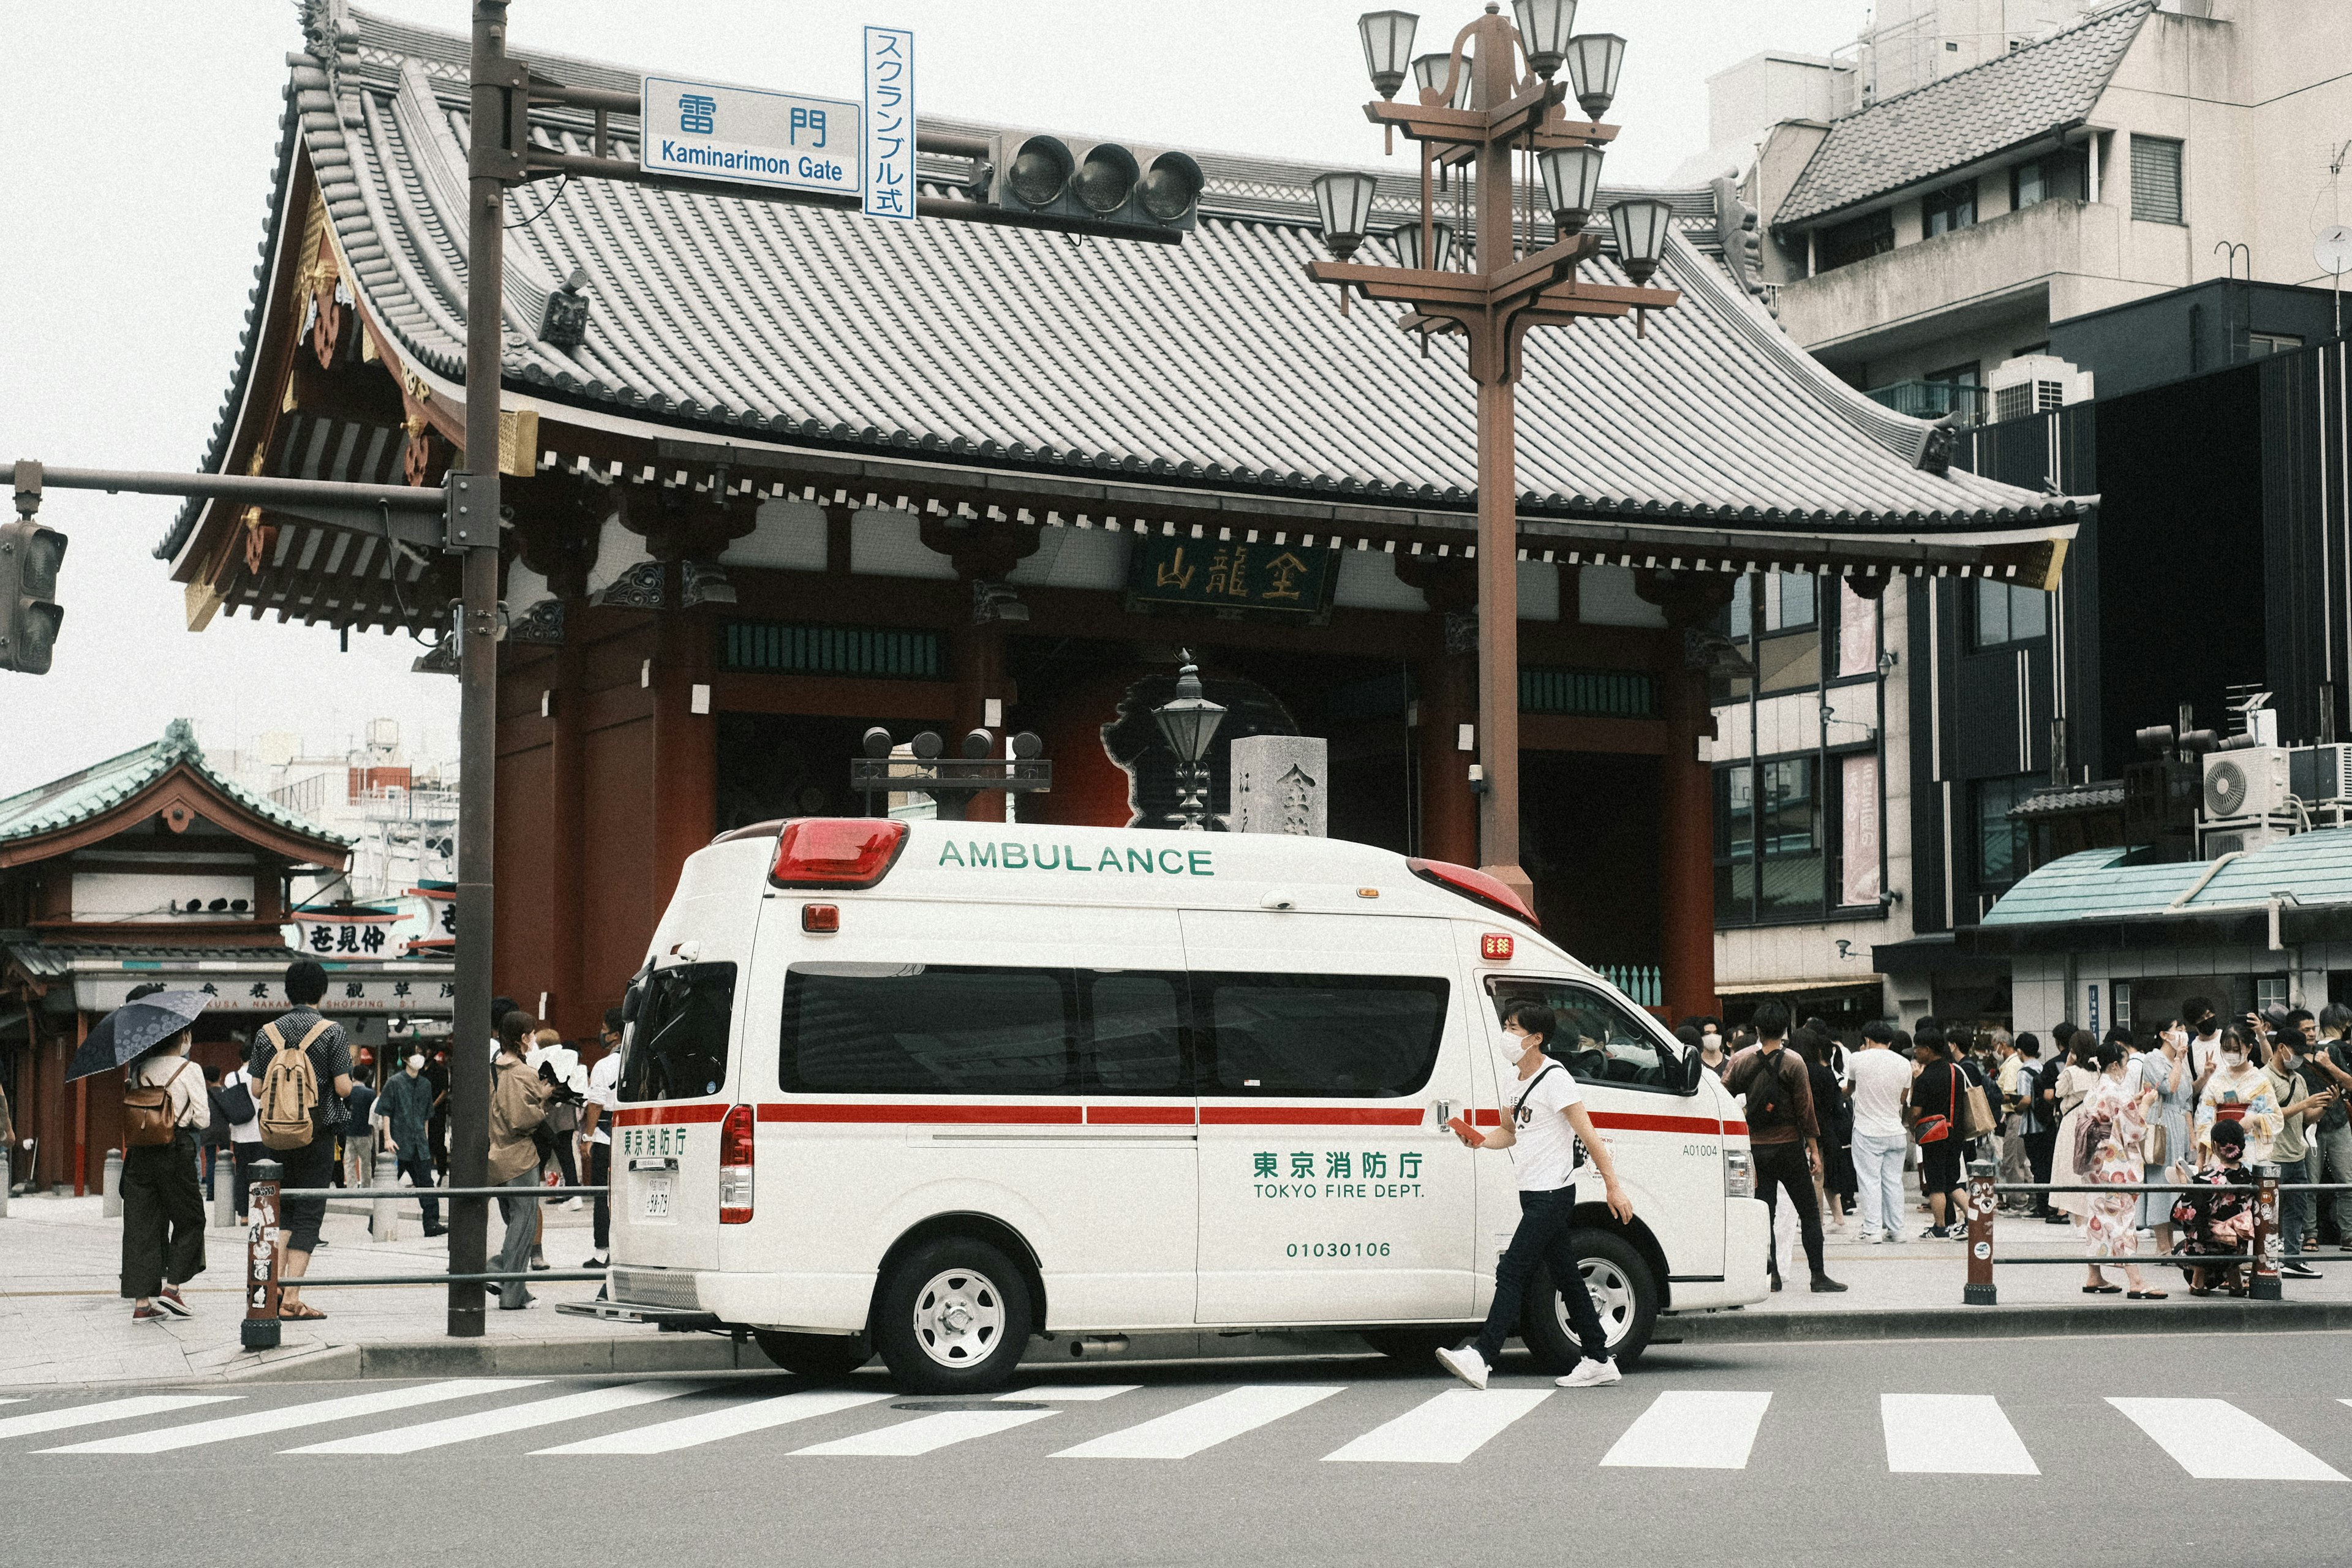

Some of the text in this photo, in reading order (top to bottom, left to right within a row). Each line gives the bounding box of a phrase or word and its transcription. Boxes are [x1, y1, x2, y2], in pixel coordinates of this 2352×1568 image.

[679, 94, 826, 148] 雷門
[876, 34, 904, 213] スクランブル式
[662, 140, 843, 182] Kaminarimon Gate
[939, 840, 1215, 876] AMBULANCE
[624, 1128, 687, 1157] 東京消防庁
[1683, 1145, 1717, 1156] A01004
[1253, 1151, 1423, 1179] 東京消防庁
[1253, 1184, 1425, 1198] TOKYO FIRE DEPT.
[1286, 1243, 1390, 1257] 01030106
